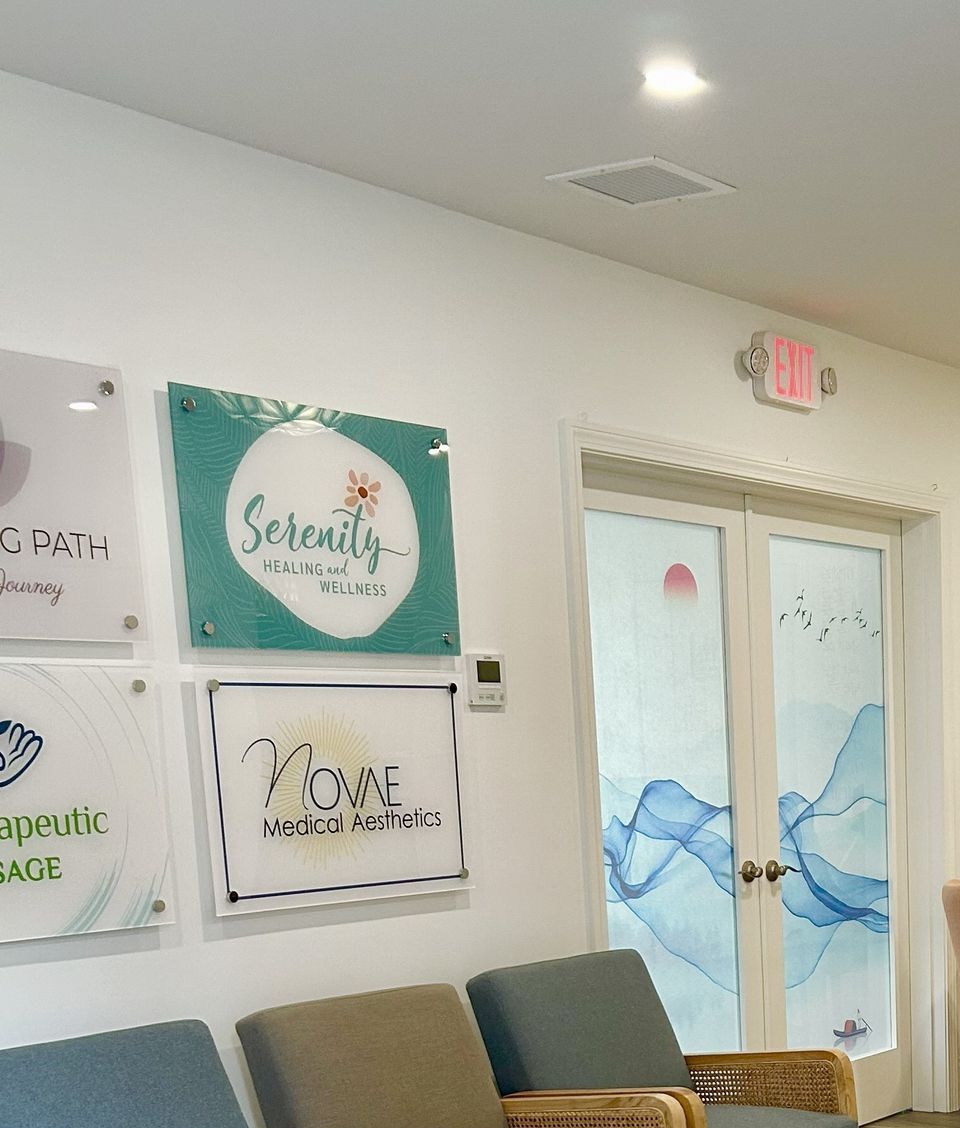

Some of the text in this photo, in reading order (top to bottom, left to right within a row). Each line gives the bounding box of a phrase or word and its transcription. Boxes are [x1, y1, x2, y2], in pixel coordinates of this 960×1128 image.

[775, 337, 815, 401] EXIT
[33, 529, 108, 560] PATH
[241, 494, 410, 575] Serenity
[263, 558, 348, 577] HEALING and
[320, 580, 387, 597] WELLNESS
[0, 806, 109, 847] apeutic
[263, 807, 441, 838] Medical Aesthetics
